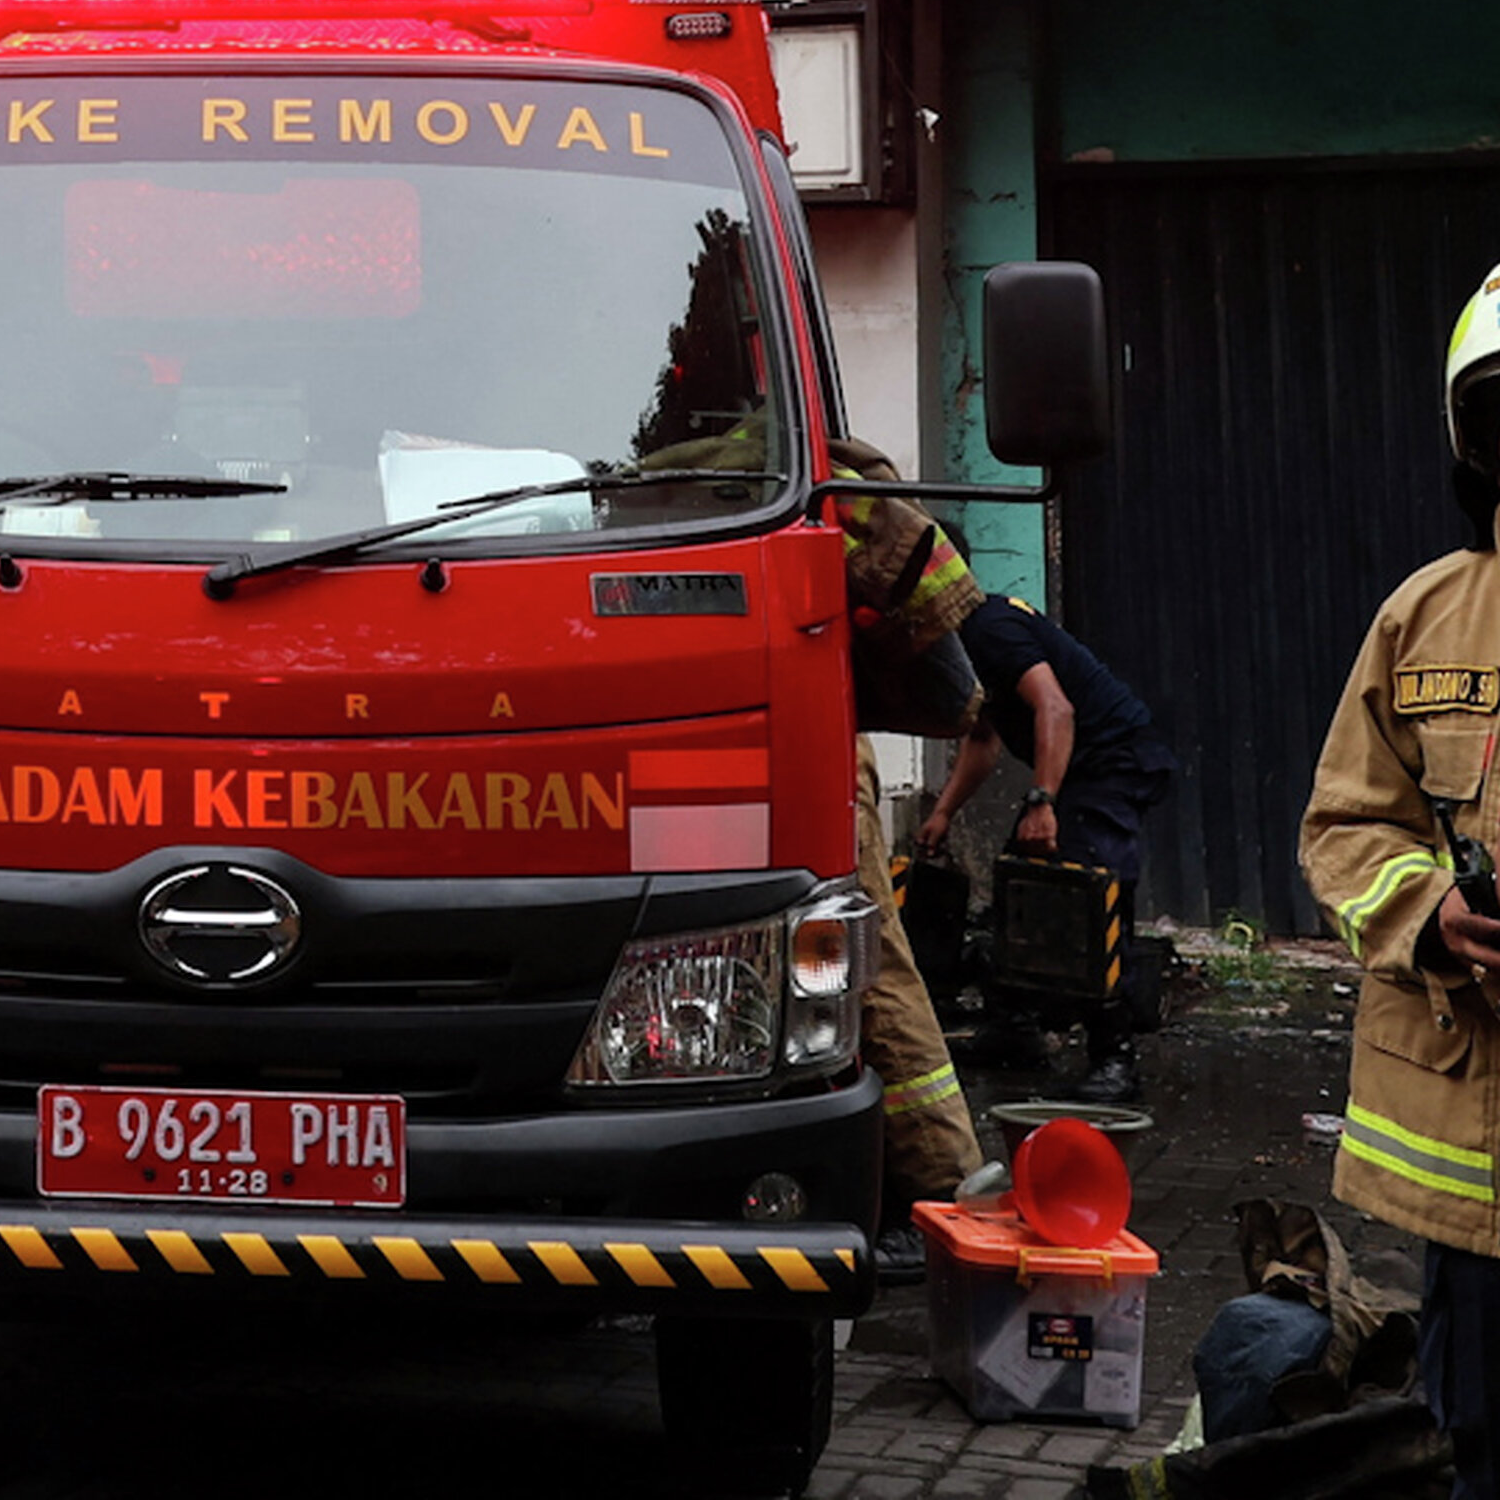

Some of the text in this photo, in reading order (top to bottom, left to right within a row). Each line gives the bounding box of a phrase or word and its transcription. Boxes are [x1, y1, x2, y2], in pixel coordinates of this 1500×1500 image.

[202, 98, 670, 158] REMOVAL
[194, 769, 625, 830] KEBAKARAN
[51, 1095, 395, 1167] B 9621 PHA
